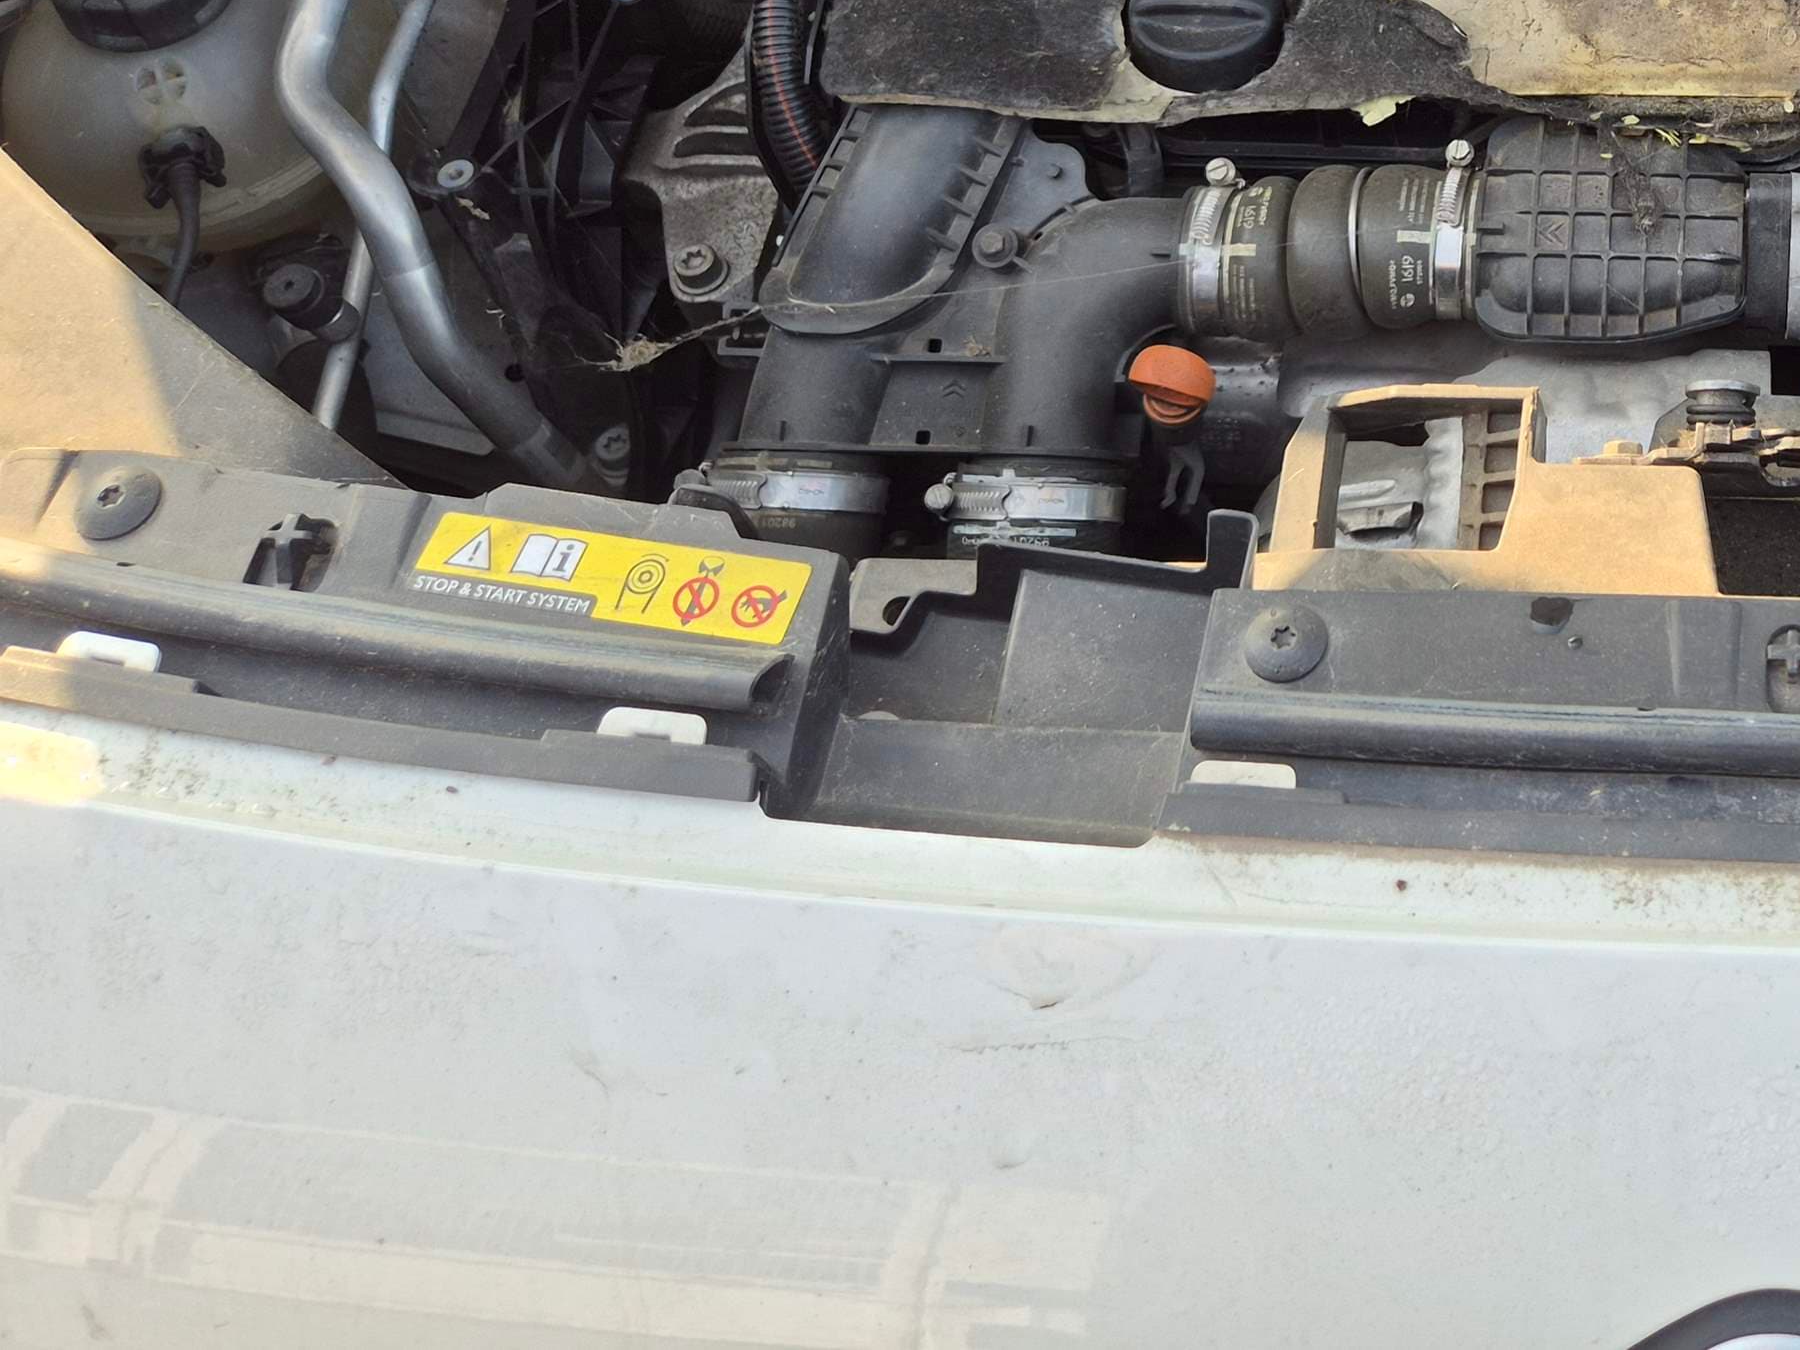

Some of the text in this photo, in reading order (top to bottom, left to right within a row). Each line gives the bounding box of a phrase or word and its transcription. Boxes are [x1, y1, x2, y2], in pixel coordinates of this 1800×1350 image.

[1401, 255, 1415, 282] 1619
[414, 575, 591, 613] STOP & START SYSTEM
